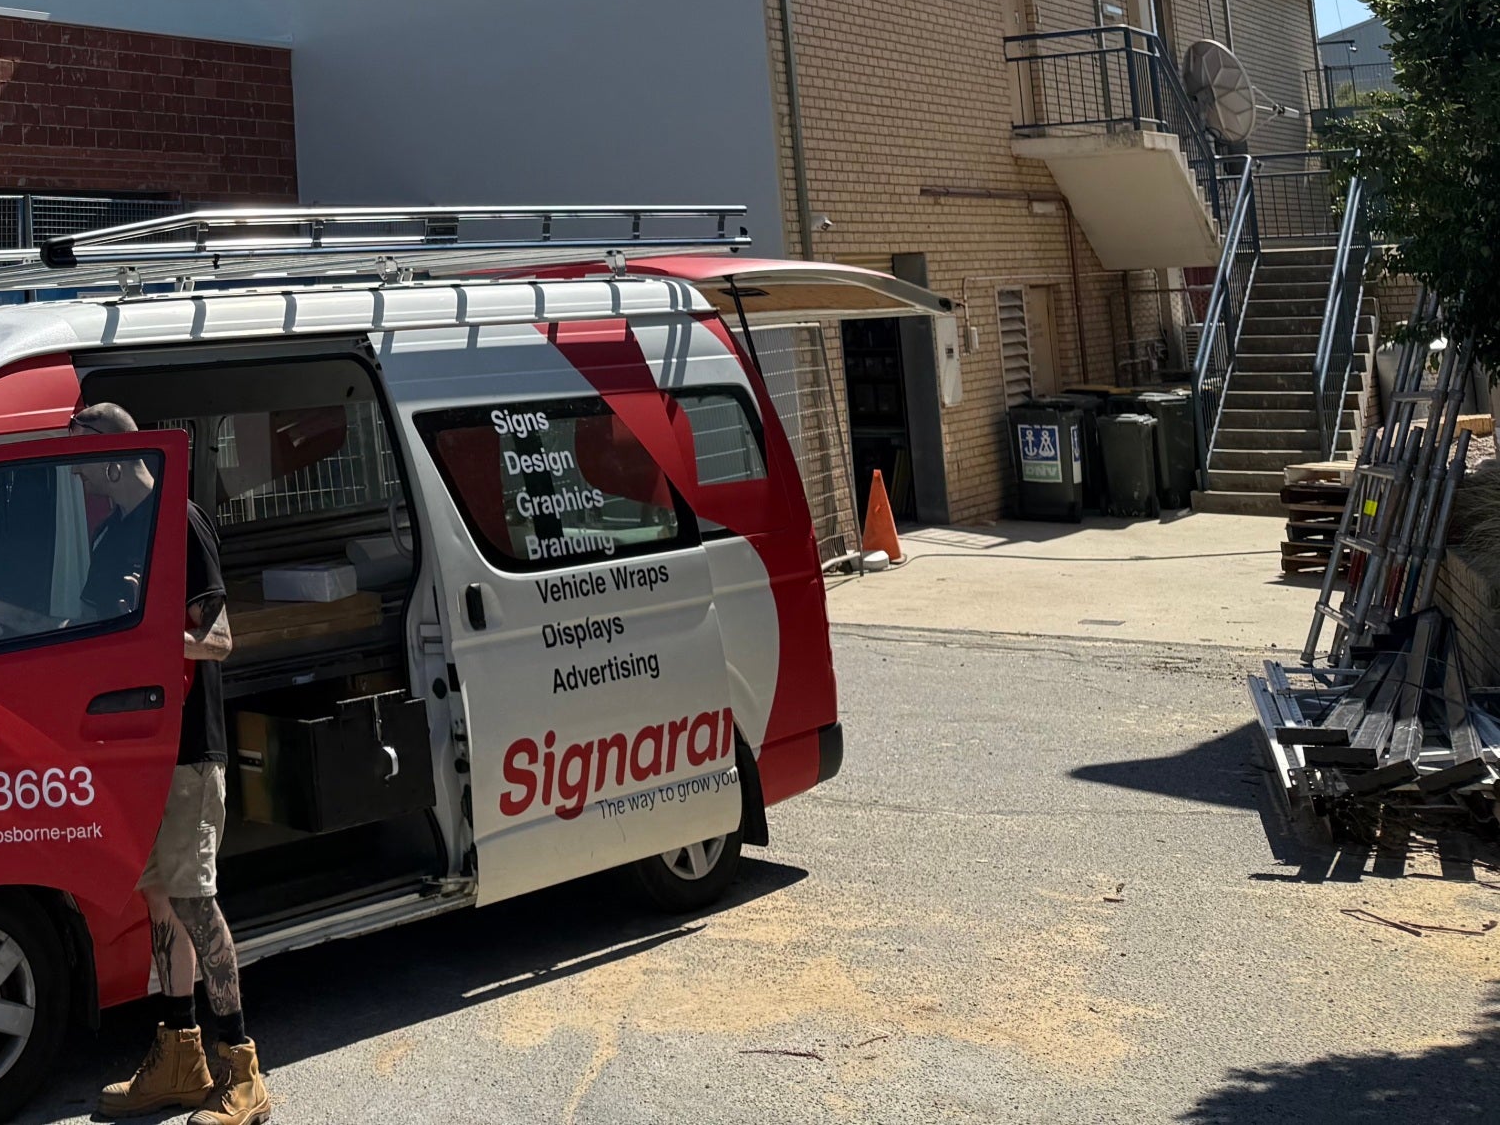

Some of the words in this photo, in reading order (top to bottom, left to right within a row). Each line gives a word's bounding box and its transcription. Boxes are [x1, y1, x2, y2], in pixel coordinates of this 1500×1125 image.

[490, 409, 550, 438] Signs
[503, 447, 575, 476] Design
[516, 485, 605, 519] Graphics
[525, 534, 616, 561] Branding
[535, 571, 607, 604] Vehicle
[609, 564, 670, 592] Wraps
[542, 616, 625, 649] Displays
[553, 652, 660, 694] Advertising
[595, 798, 626, 820] The
[627, 789, 656, 811] way
[658, 786, 675, 803] to
[677, 776, 710, 802] grow
